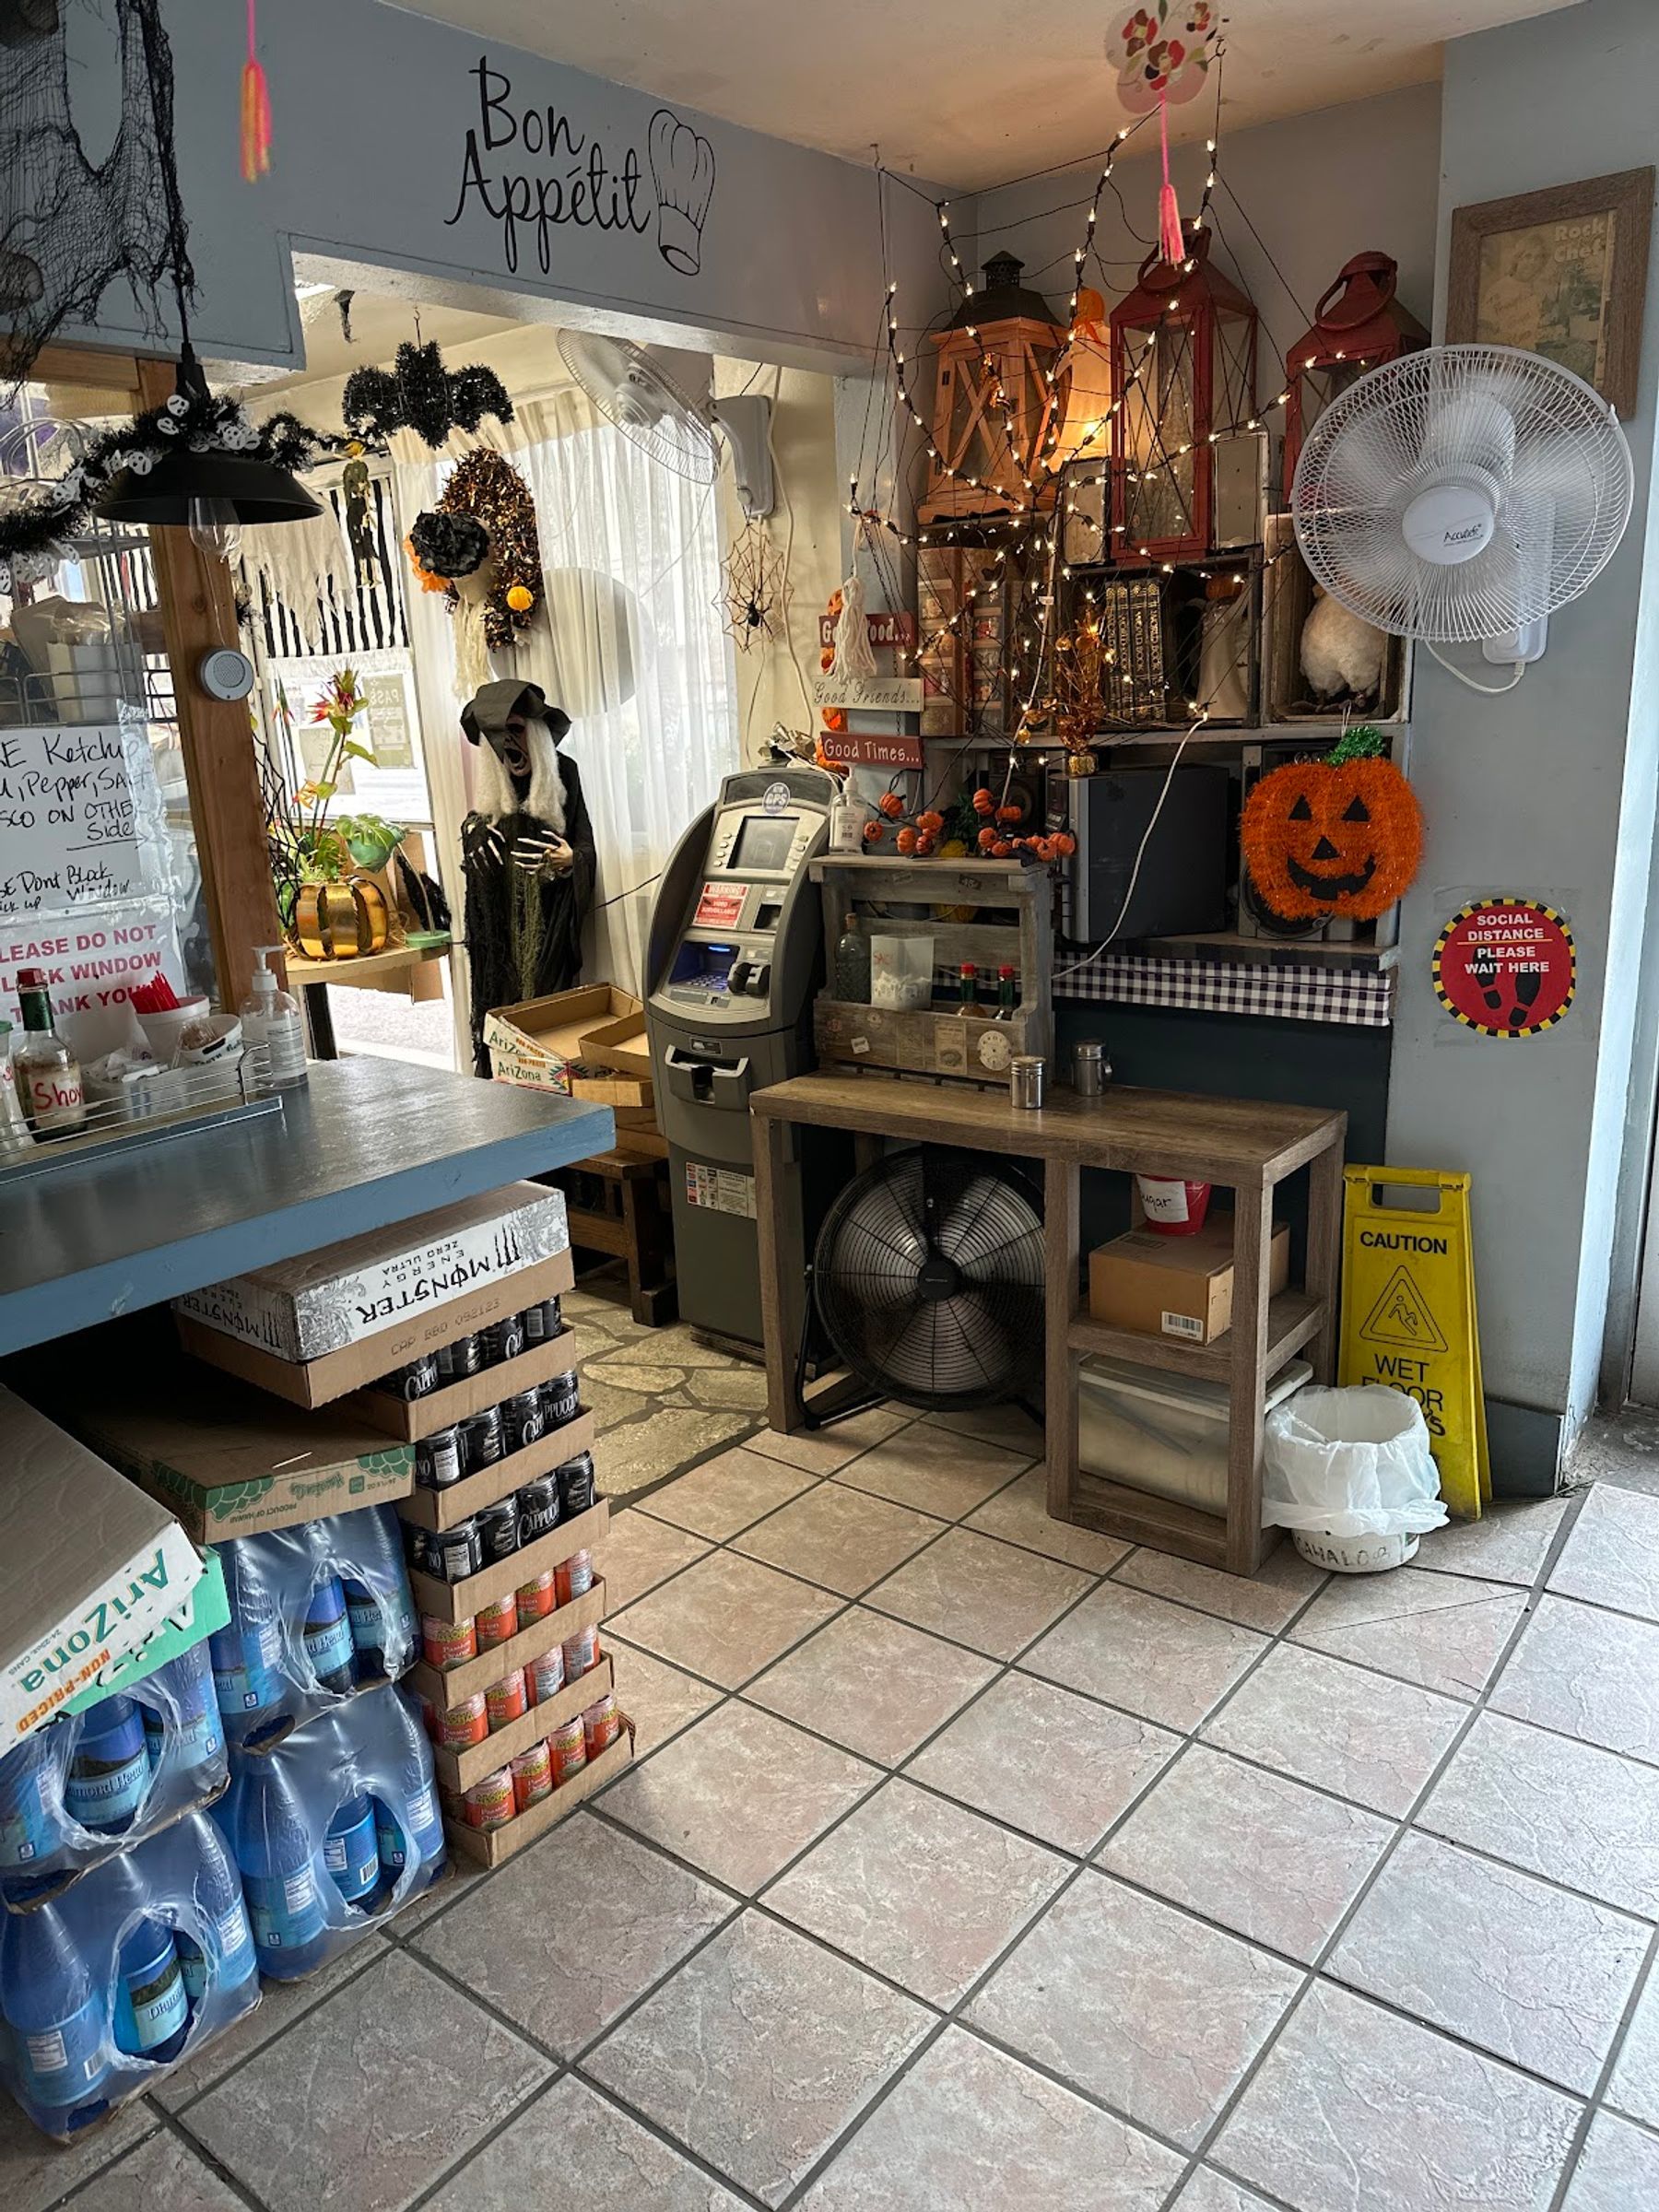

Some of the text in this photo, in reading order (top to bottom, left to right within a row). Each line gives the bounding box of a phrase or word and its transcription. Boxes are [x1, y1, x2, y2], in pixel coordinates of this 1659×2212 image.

[468, 55, 584, 157] Bon
[444, 129, 651, 274] Appétit
[1555, 218, 1606, 242] Rock
[814, 681, 847, 704] Good
[823, 737, 859, 759] Good
[764, 792, 788, 806] GPS
[48, 805, 75, 825] ON
[87, 819, 135, 841] Side
[1477, 913, 1534, 926] SOCIAL
[76, 932, 107, 951] DO
[113, 924, 157, 946] NOT
[1467, 928, 1545, 942] DISTANCE
[1477, 947, 1536, 959] PLEASE
[1, 951, 162, 993] LK WINDOW
[1465, 961, 1550, 974] WAIT HERE
[498, 1061, 542, 1082] AriZona
[1359, 1230, 1448, 1255] CAUTION
[382, 1249, 465, 1289] ENERGY
[1373, 1353, 1430, 1383] WET
[18, 1547, 170, 1693] AriZona
[16, 1647, 112, 1735] NON-PRICED
